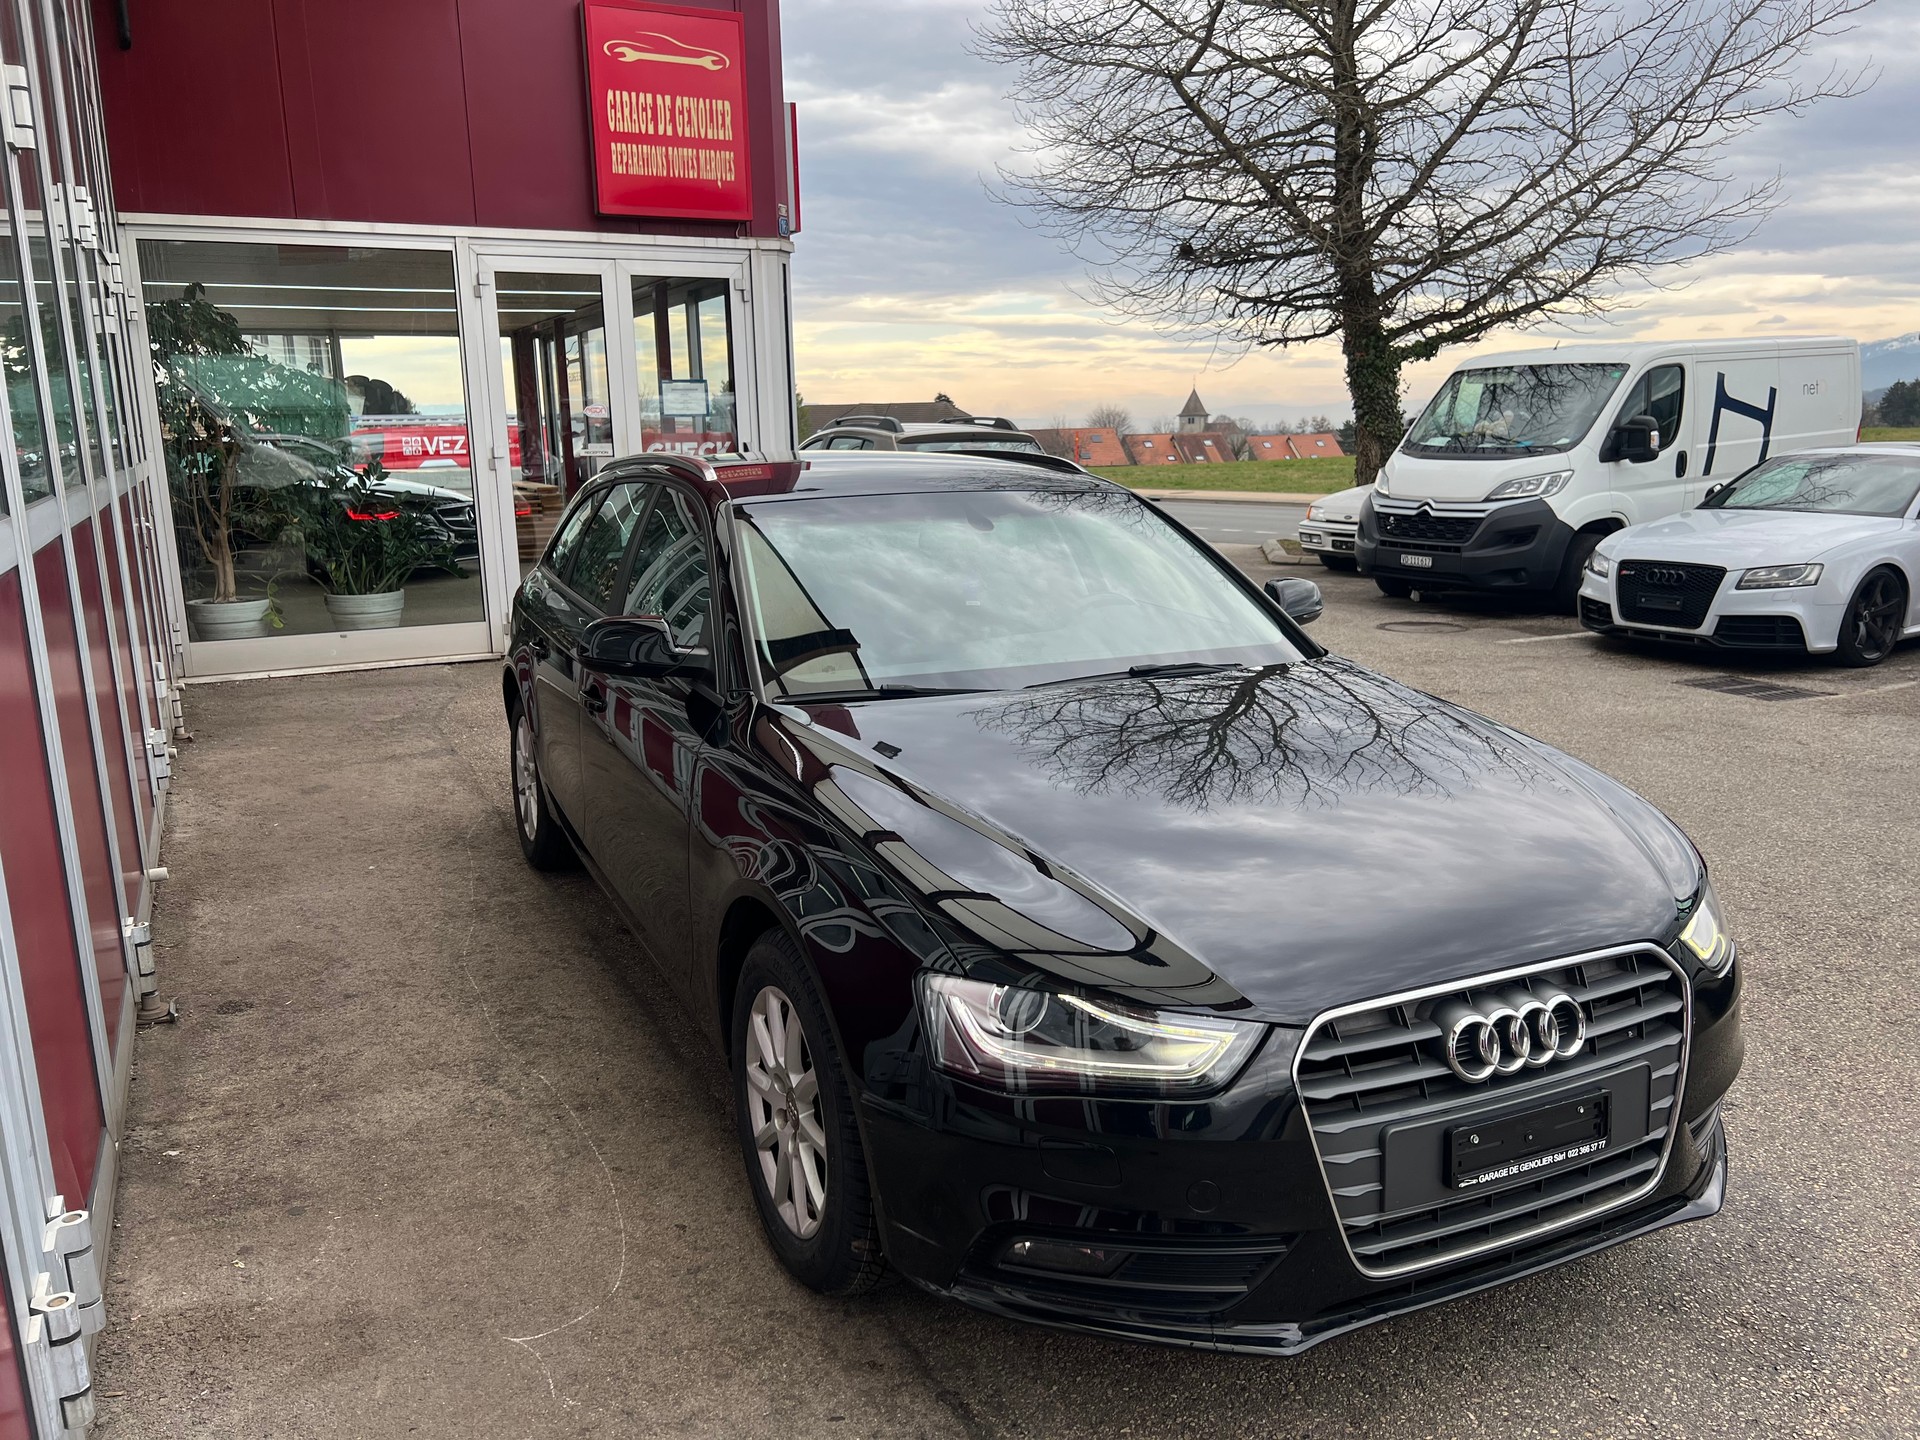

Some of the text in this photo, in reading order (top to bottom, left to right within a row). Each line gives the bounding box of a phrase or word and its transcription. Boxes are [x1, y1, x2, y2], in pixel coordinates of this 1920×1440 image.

[607, 88, 733, 141] GARAGE DE GENOLIER
[610, 142, 735, 189] REPARATIONS TOUTES MARQUES
[423, 435, 467, 455] VEZ
[646, 441, 732, 457] CHECK
[1478, 1168, 1509, 1183] GARAGE
[1509, 1165, 1519, 1175] DE
[1519, 1155, 1553, 1172] GENOLIER
[1567, 1148, 1579, 1158] 022
[1579, 1145, 1590, 1155] 366
[1590, 1142, 1598, 1152] 37
[1598, 1140, 1606, 1149] 77
